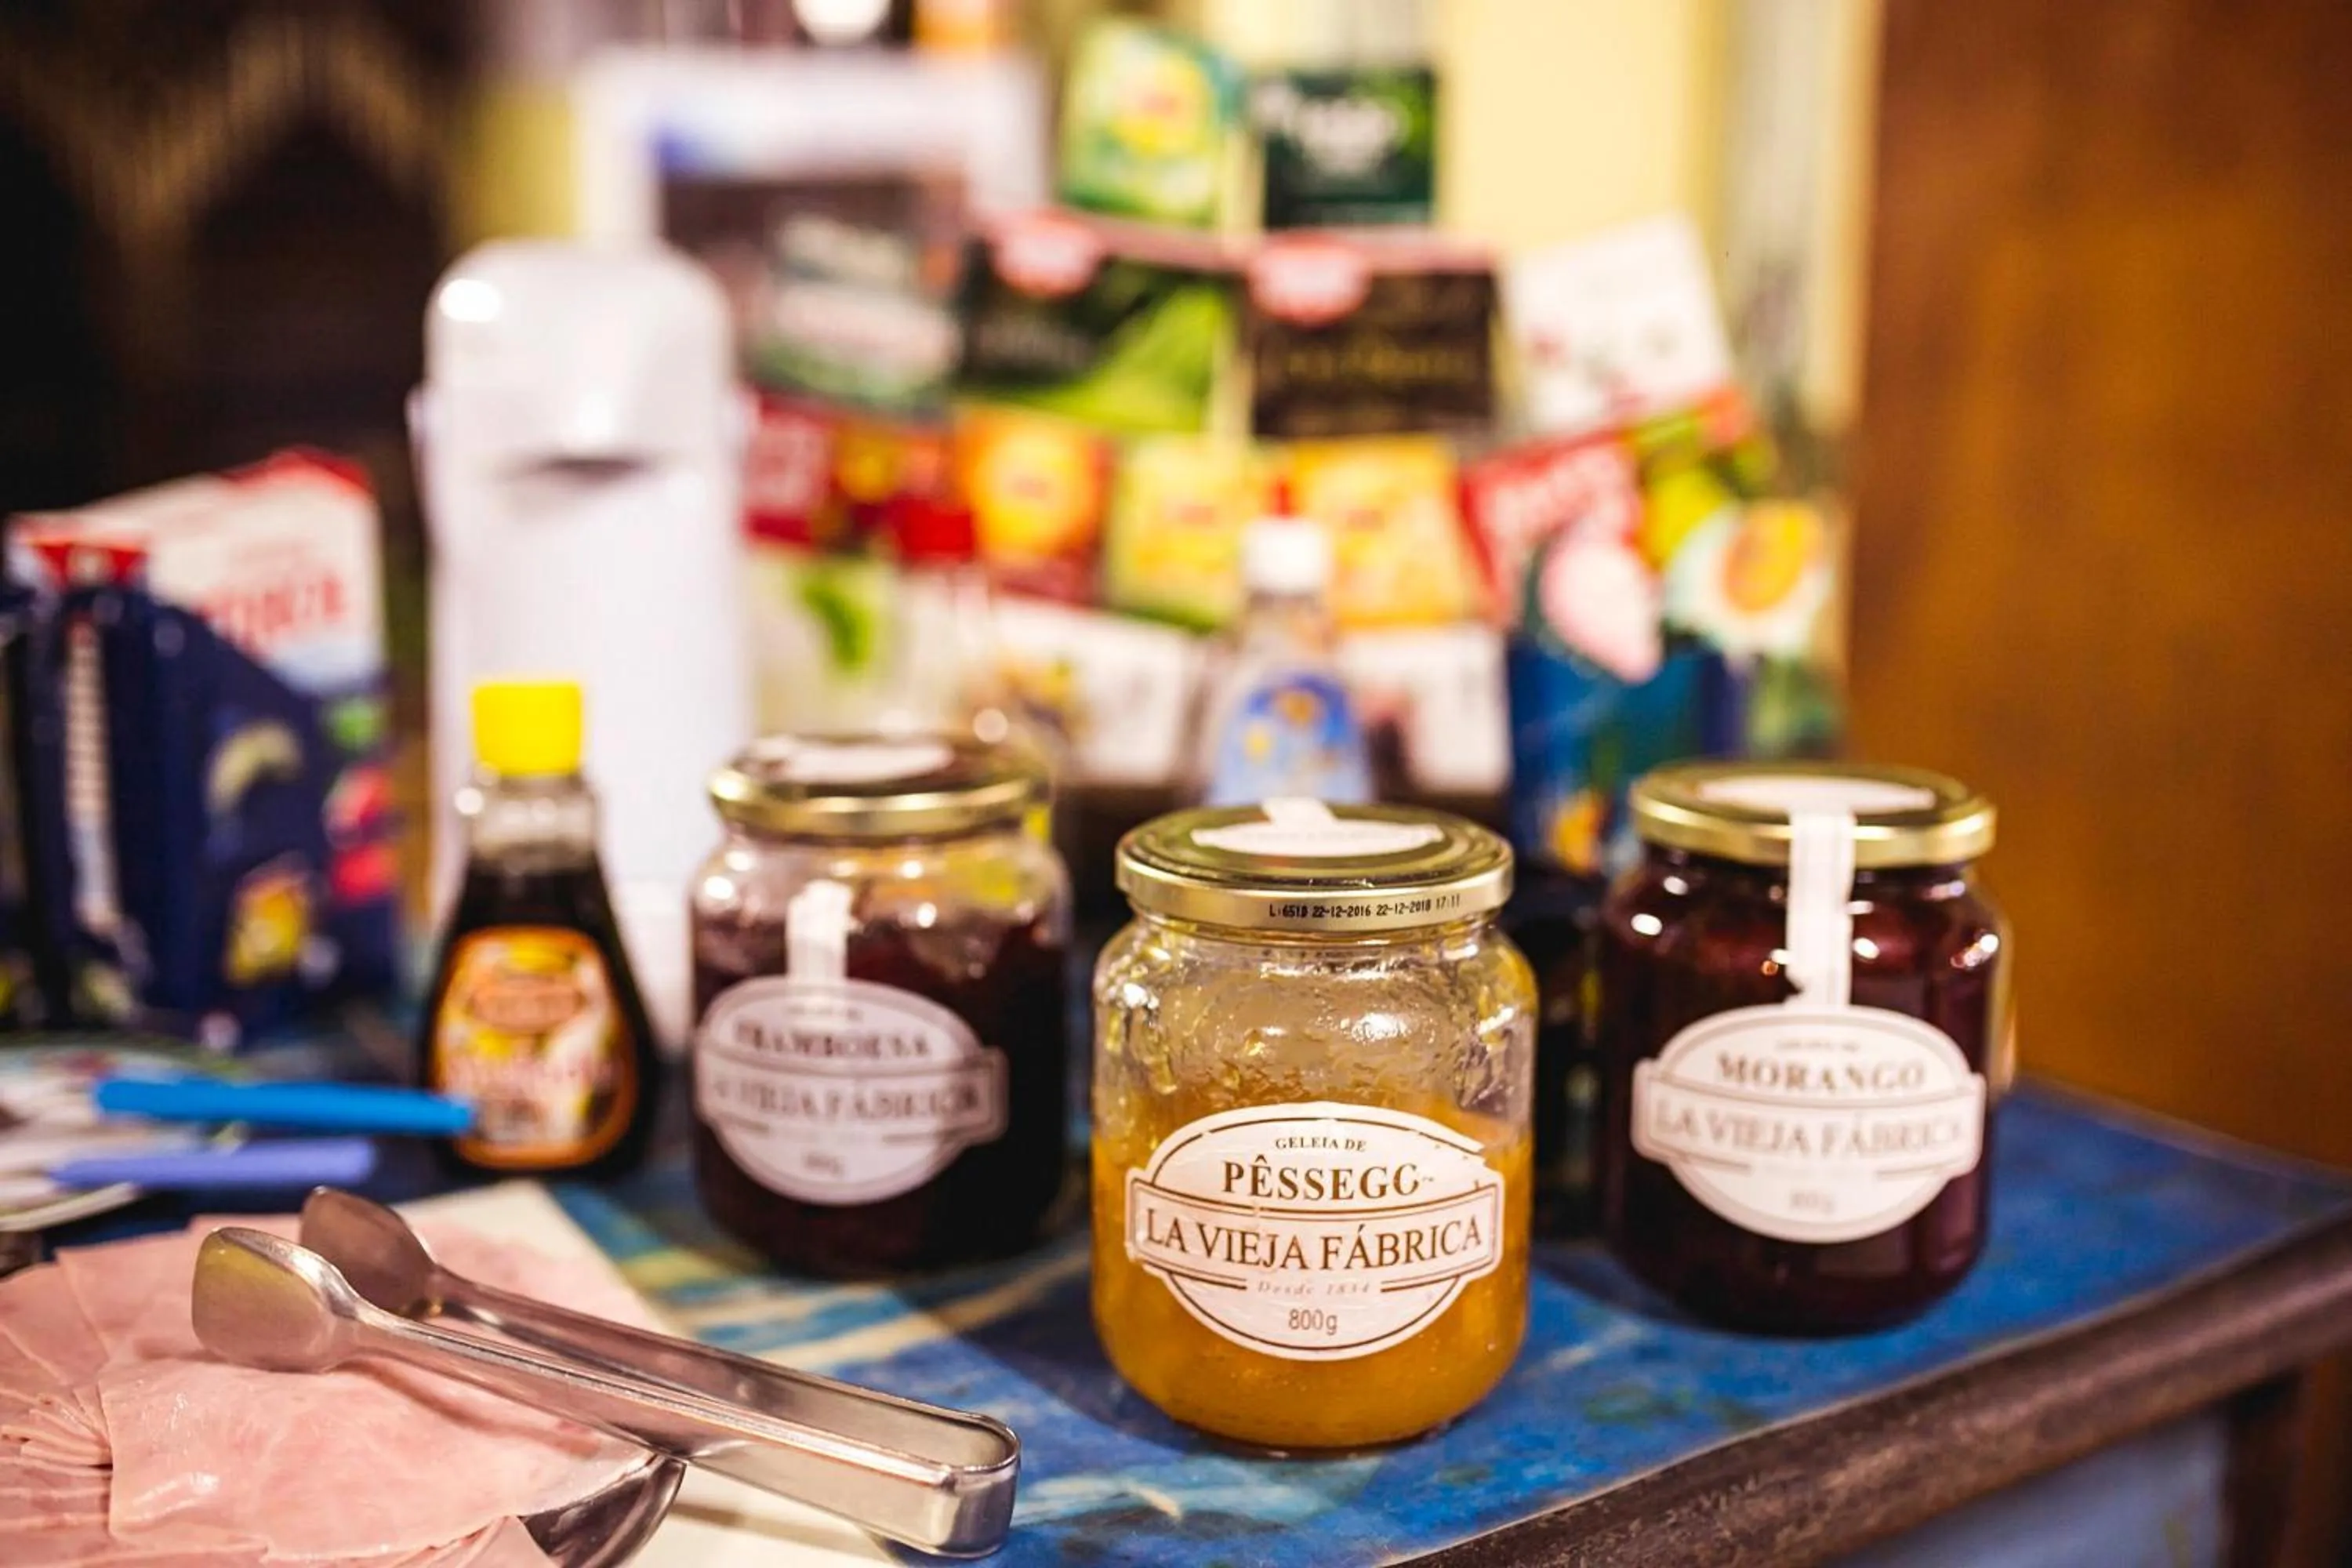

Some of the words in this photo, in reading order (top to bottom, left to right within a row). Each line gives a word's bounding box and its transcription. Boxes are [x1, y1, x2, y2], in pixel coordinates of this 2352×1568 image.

[1312, 903, 1372, 918] 22-12-2016
[1376, 898, 1432, 916] 22-12-2018
[1715, 1051, 1928, 1093] MORANGO
[1275, 1136, 1339, 1151] GELEIA
[1344, 1138, 1367, 1152] DE
[1653, 1098, 1700, 1138] LA
[1704, 1108, 1812, 1156] VIEJA
[1146, 1207, 1189, 1254] LA
[1196, 1220, 1307, 1271] VIEJA
[1319, 1214, 1483, 1271] FÁBRICA
[1288, 1308, 1338, 1336] 800g
